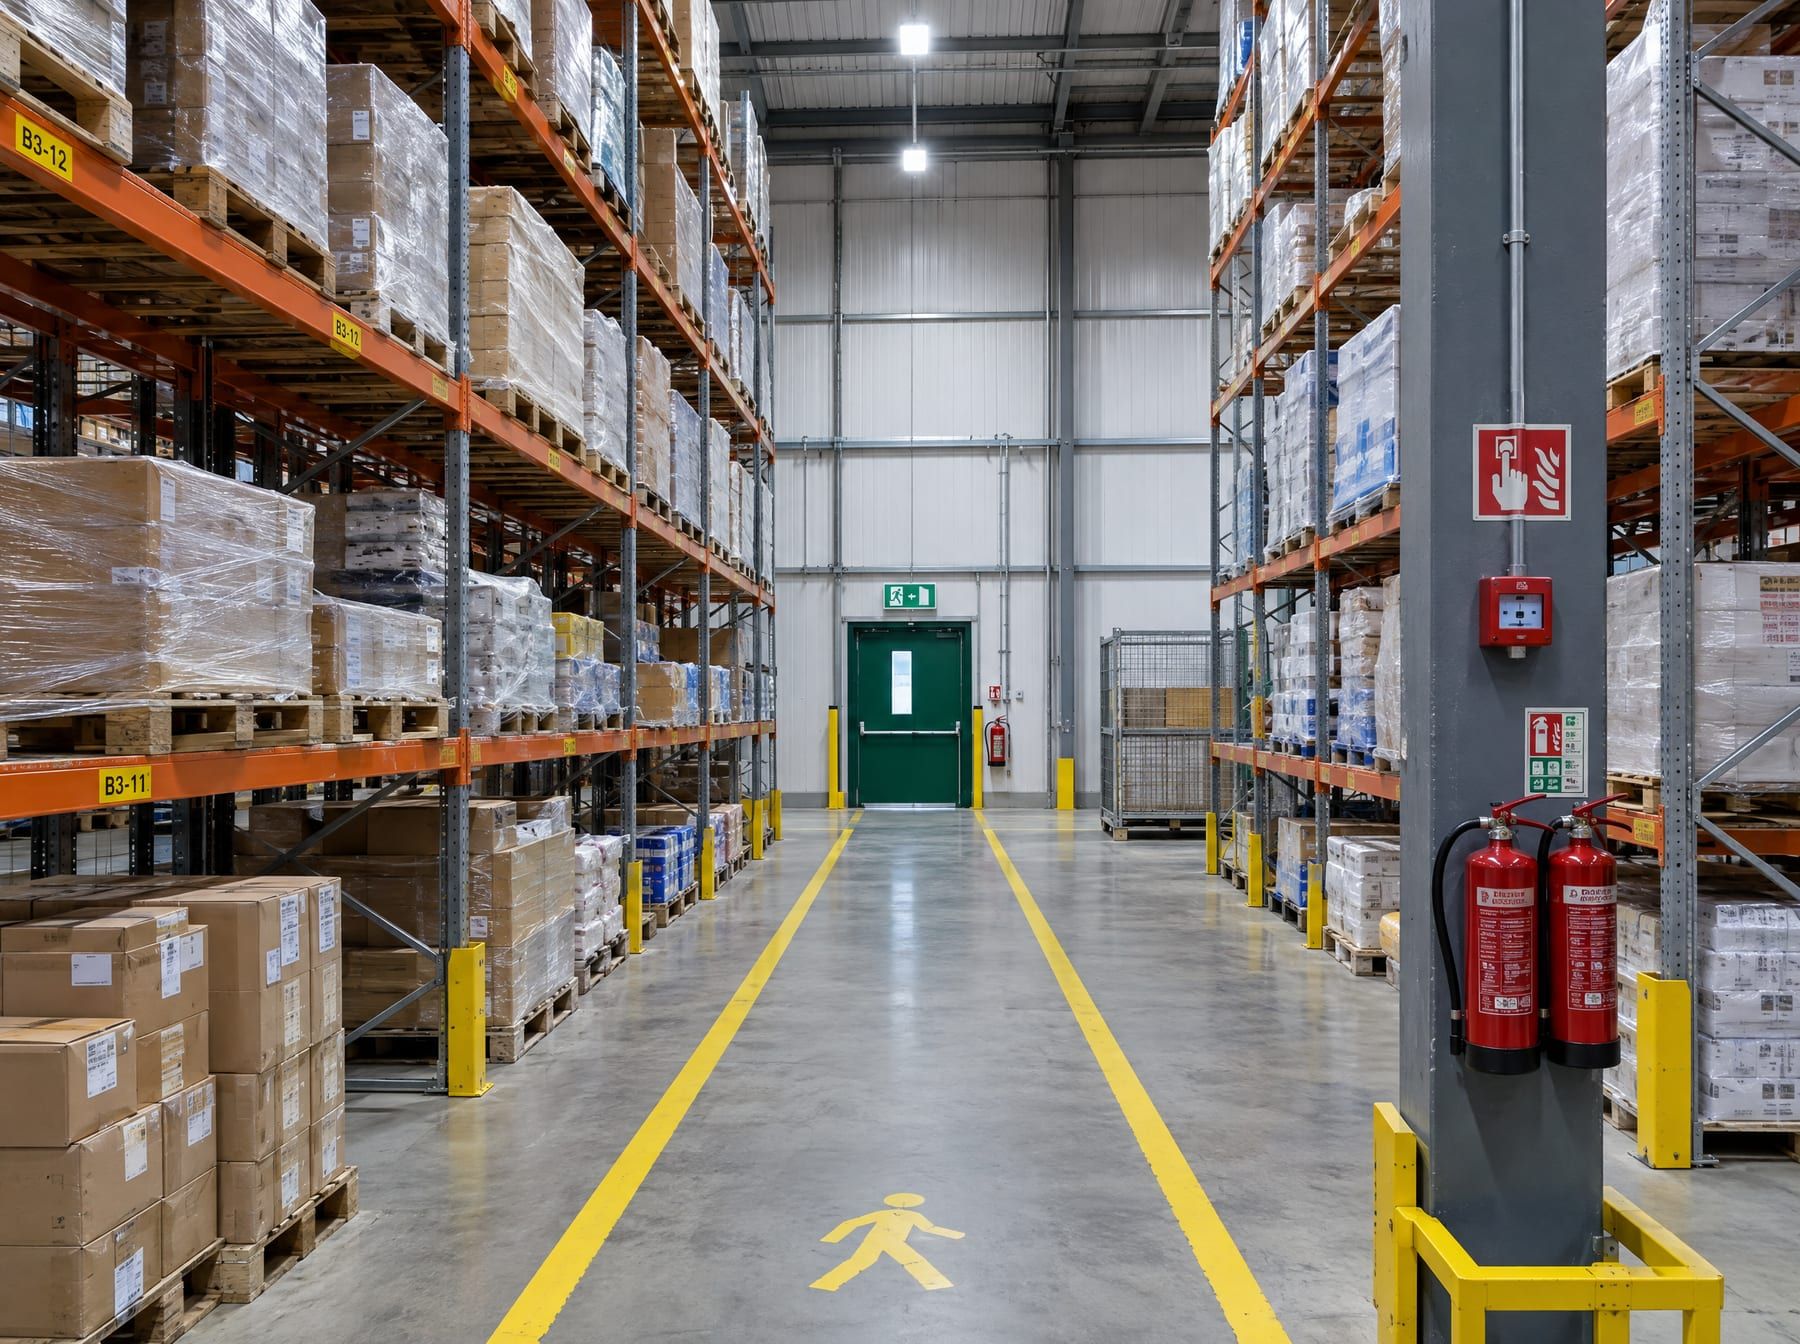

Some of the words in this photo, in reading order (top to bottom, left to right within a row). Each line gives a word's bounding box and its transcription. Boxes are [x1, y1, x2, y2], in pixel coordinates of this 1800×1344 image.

[22, 125, 67, 173] B3-12
[336, 319, 359, 346] B3-12
[105, 773, 145, 796] B3-11
